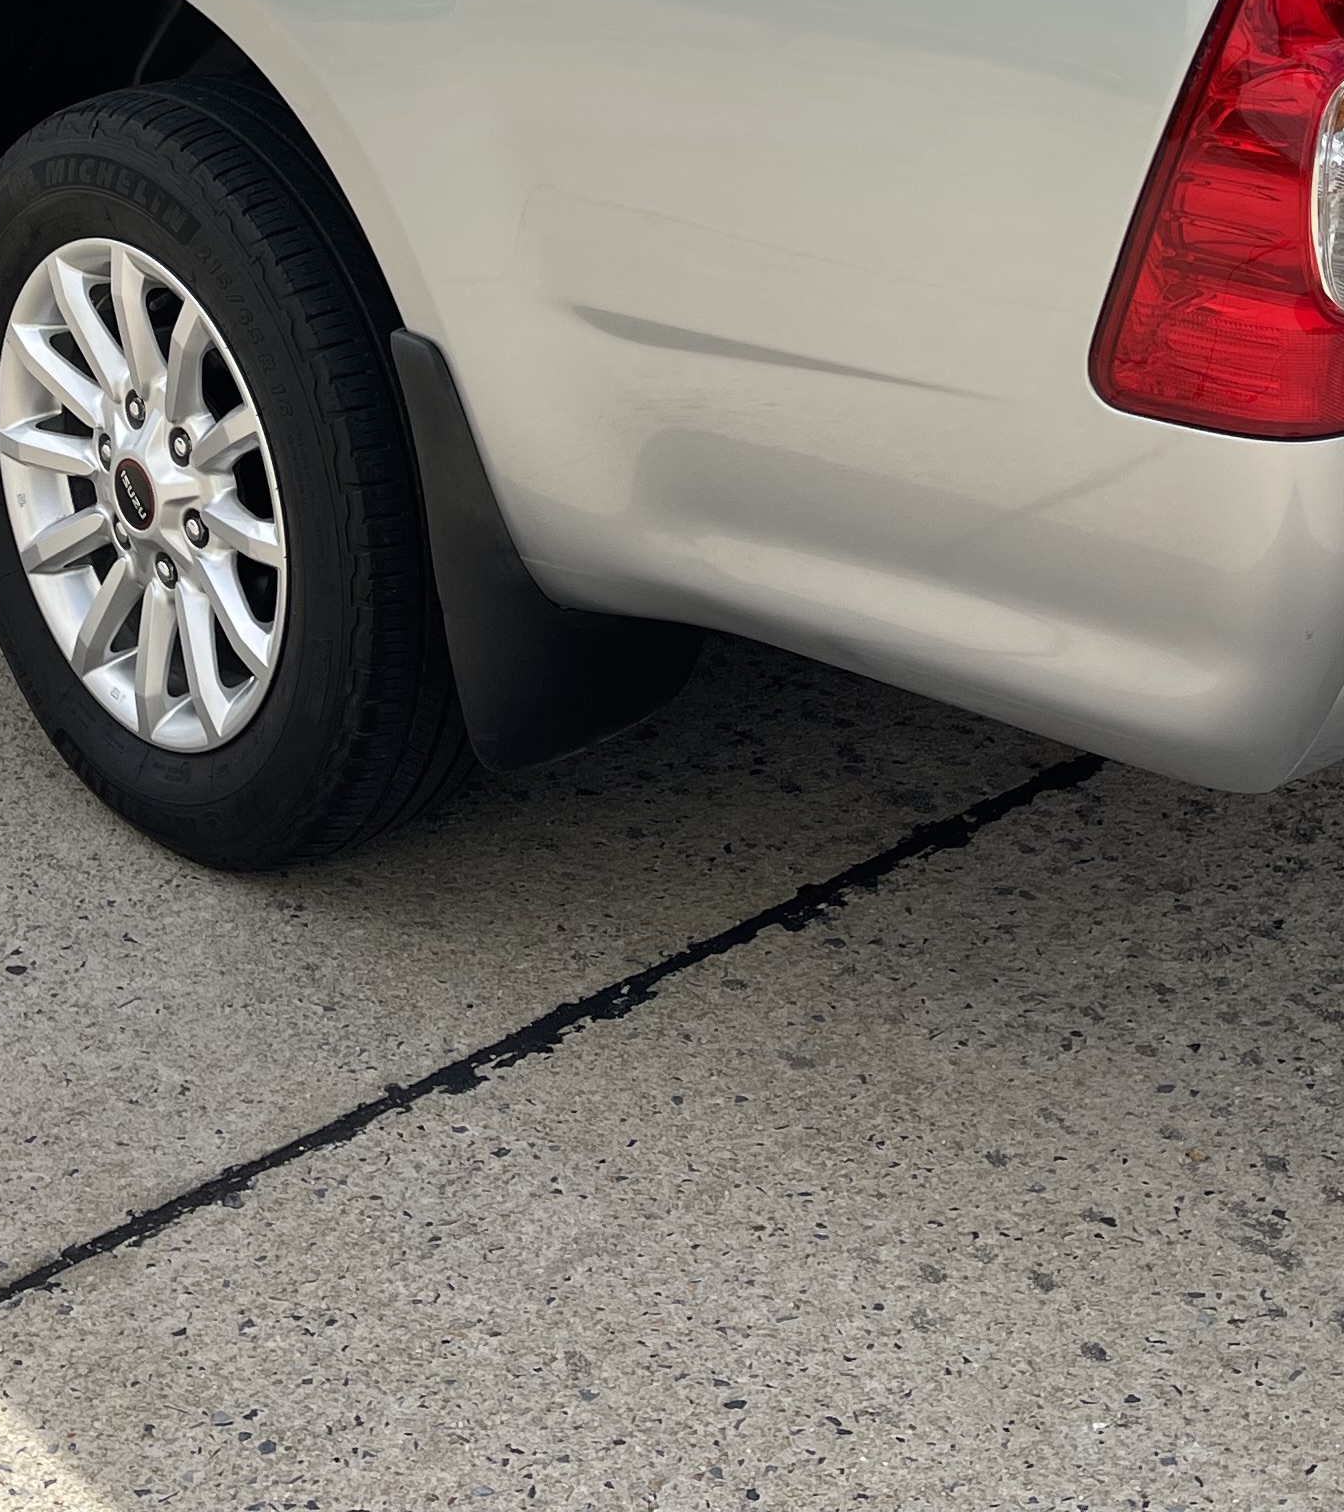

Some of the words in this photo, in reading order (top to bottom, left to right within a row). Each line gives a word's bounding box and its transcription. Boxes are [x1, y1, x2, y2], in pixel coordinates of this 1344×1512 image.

[44, 157, 189, 234] MICHELIN
[195, 246, 263, 346] 215/65
[271, 382, 295, 419] 16
[120, 470, 147, 520] ISUZU
